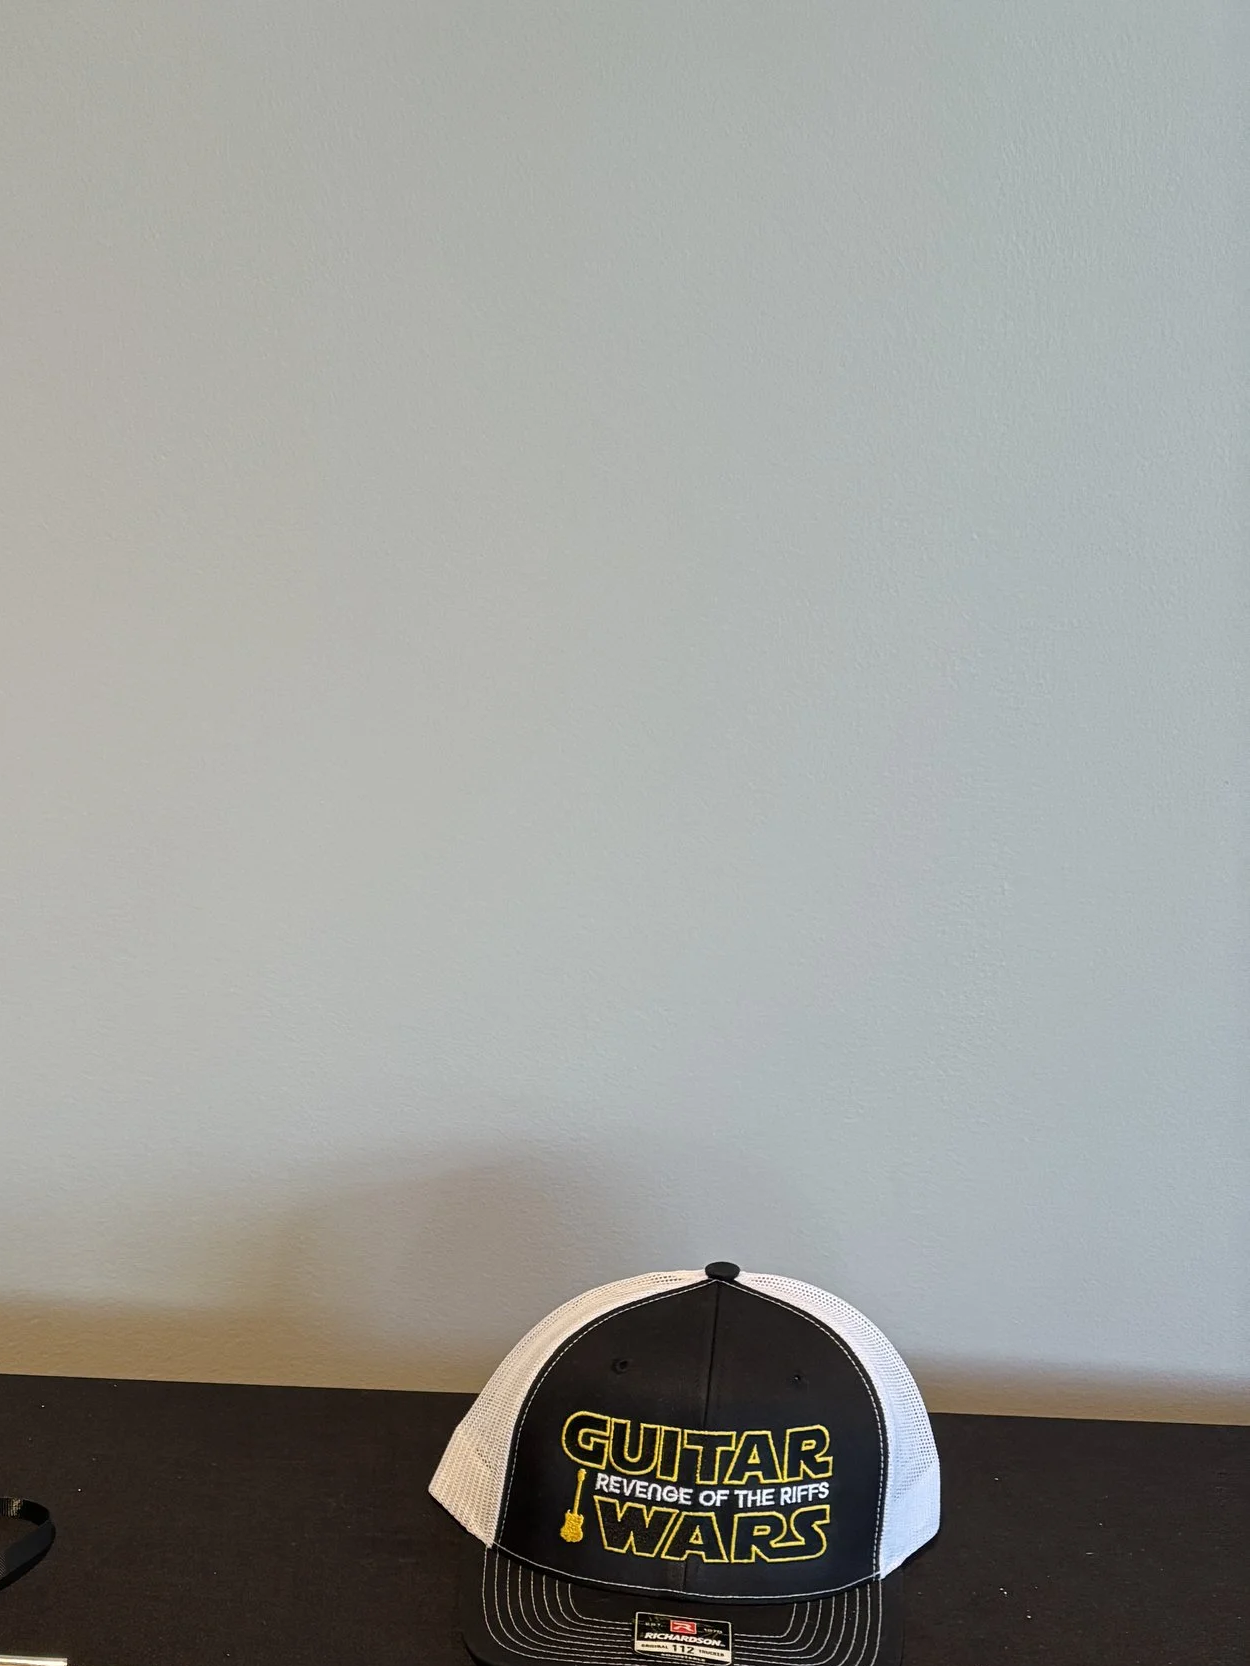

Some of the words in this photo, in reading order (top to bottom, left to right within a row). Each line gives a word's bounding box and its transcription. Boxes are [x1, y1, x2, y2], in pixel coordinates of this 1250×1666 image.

[562, 1411, 833, 1485] GUITAR
[595, 1473, 693, 1506] REVENGE
[700, 1489, 729, 1507] OF
[734, 1490, 775, 1508] THE
[780, 1482, 830, 1507] RIFFS
[593, 1495, 830, 1563] WARS
[644, 1633, 722, 1646] RICHARDSON
[672, 1645, 695, 1654] 112
